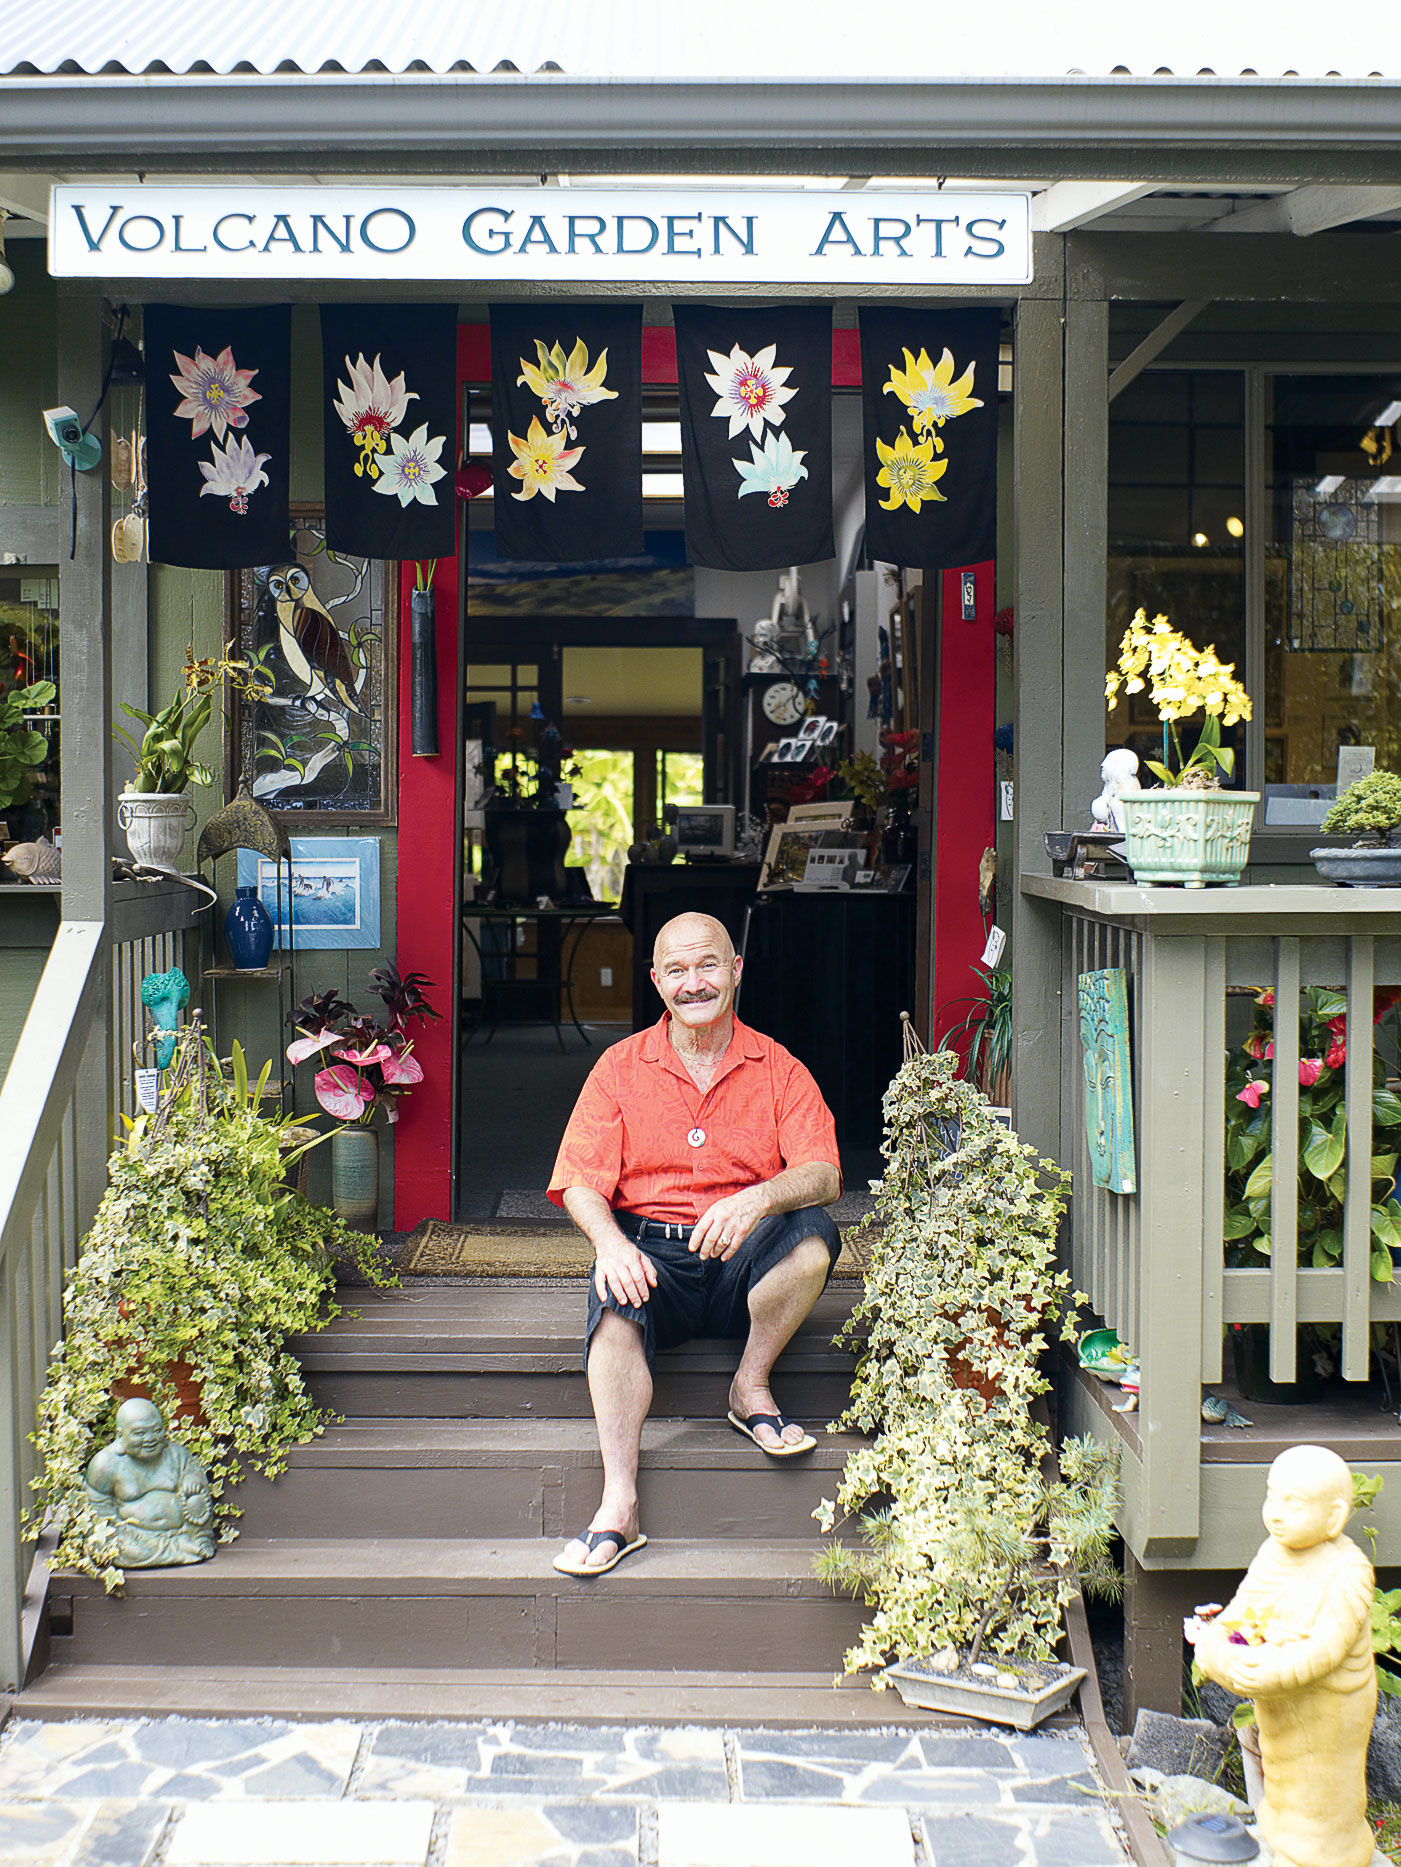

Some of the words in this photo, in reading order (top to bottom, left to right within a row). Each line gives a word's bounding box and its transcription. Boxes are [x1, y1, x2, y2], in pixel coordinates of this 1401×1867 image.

[71, 205, 416, 254] VOLCANO
[461, 207, 758, 256] GARDEN
[809, 212, 1006, 259] ARTS
